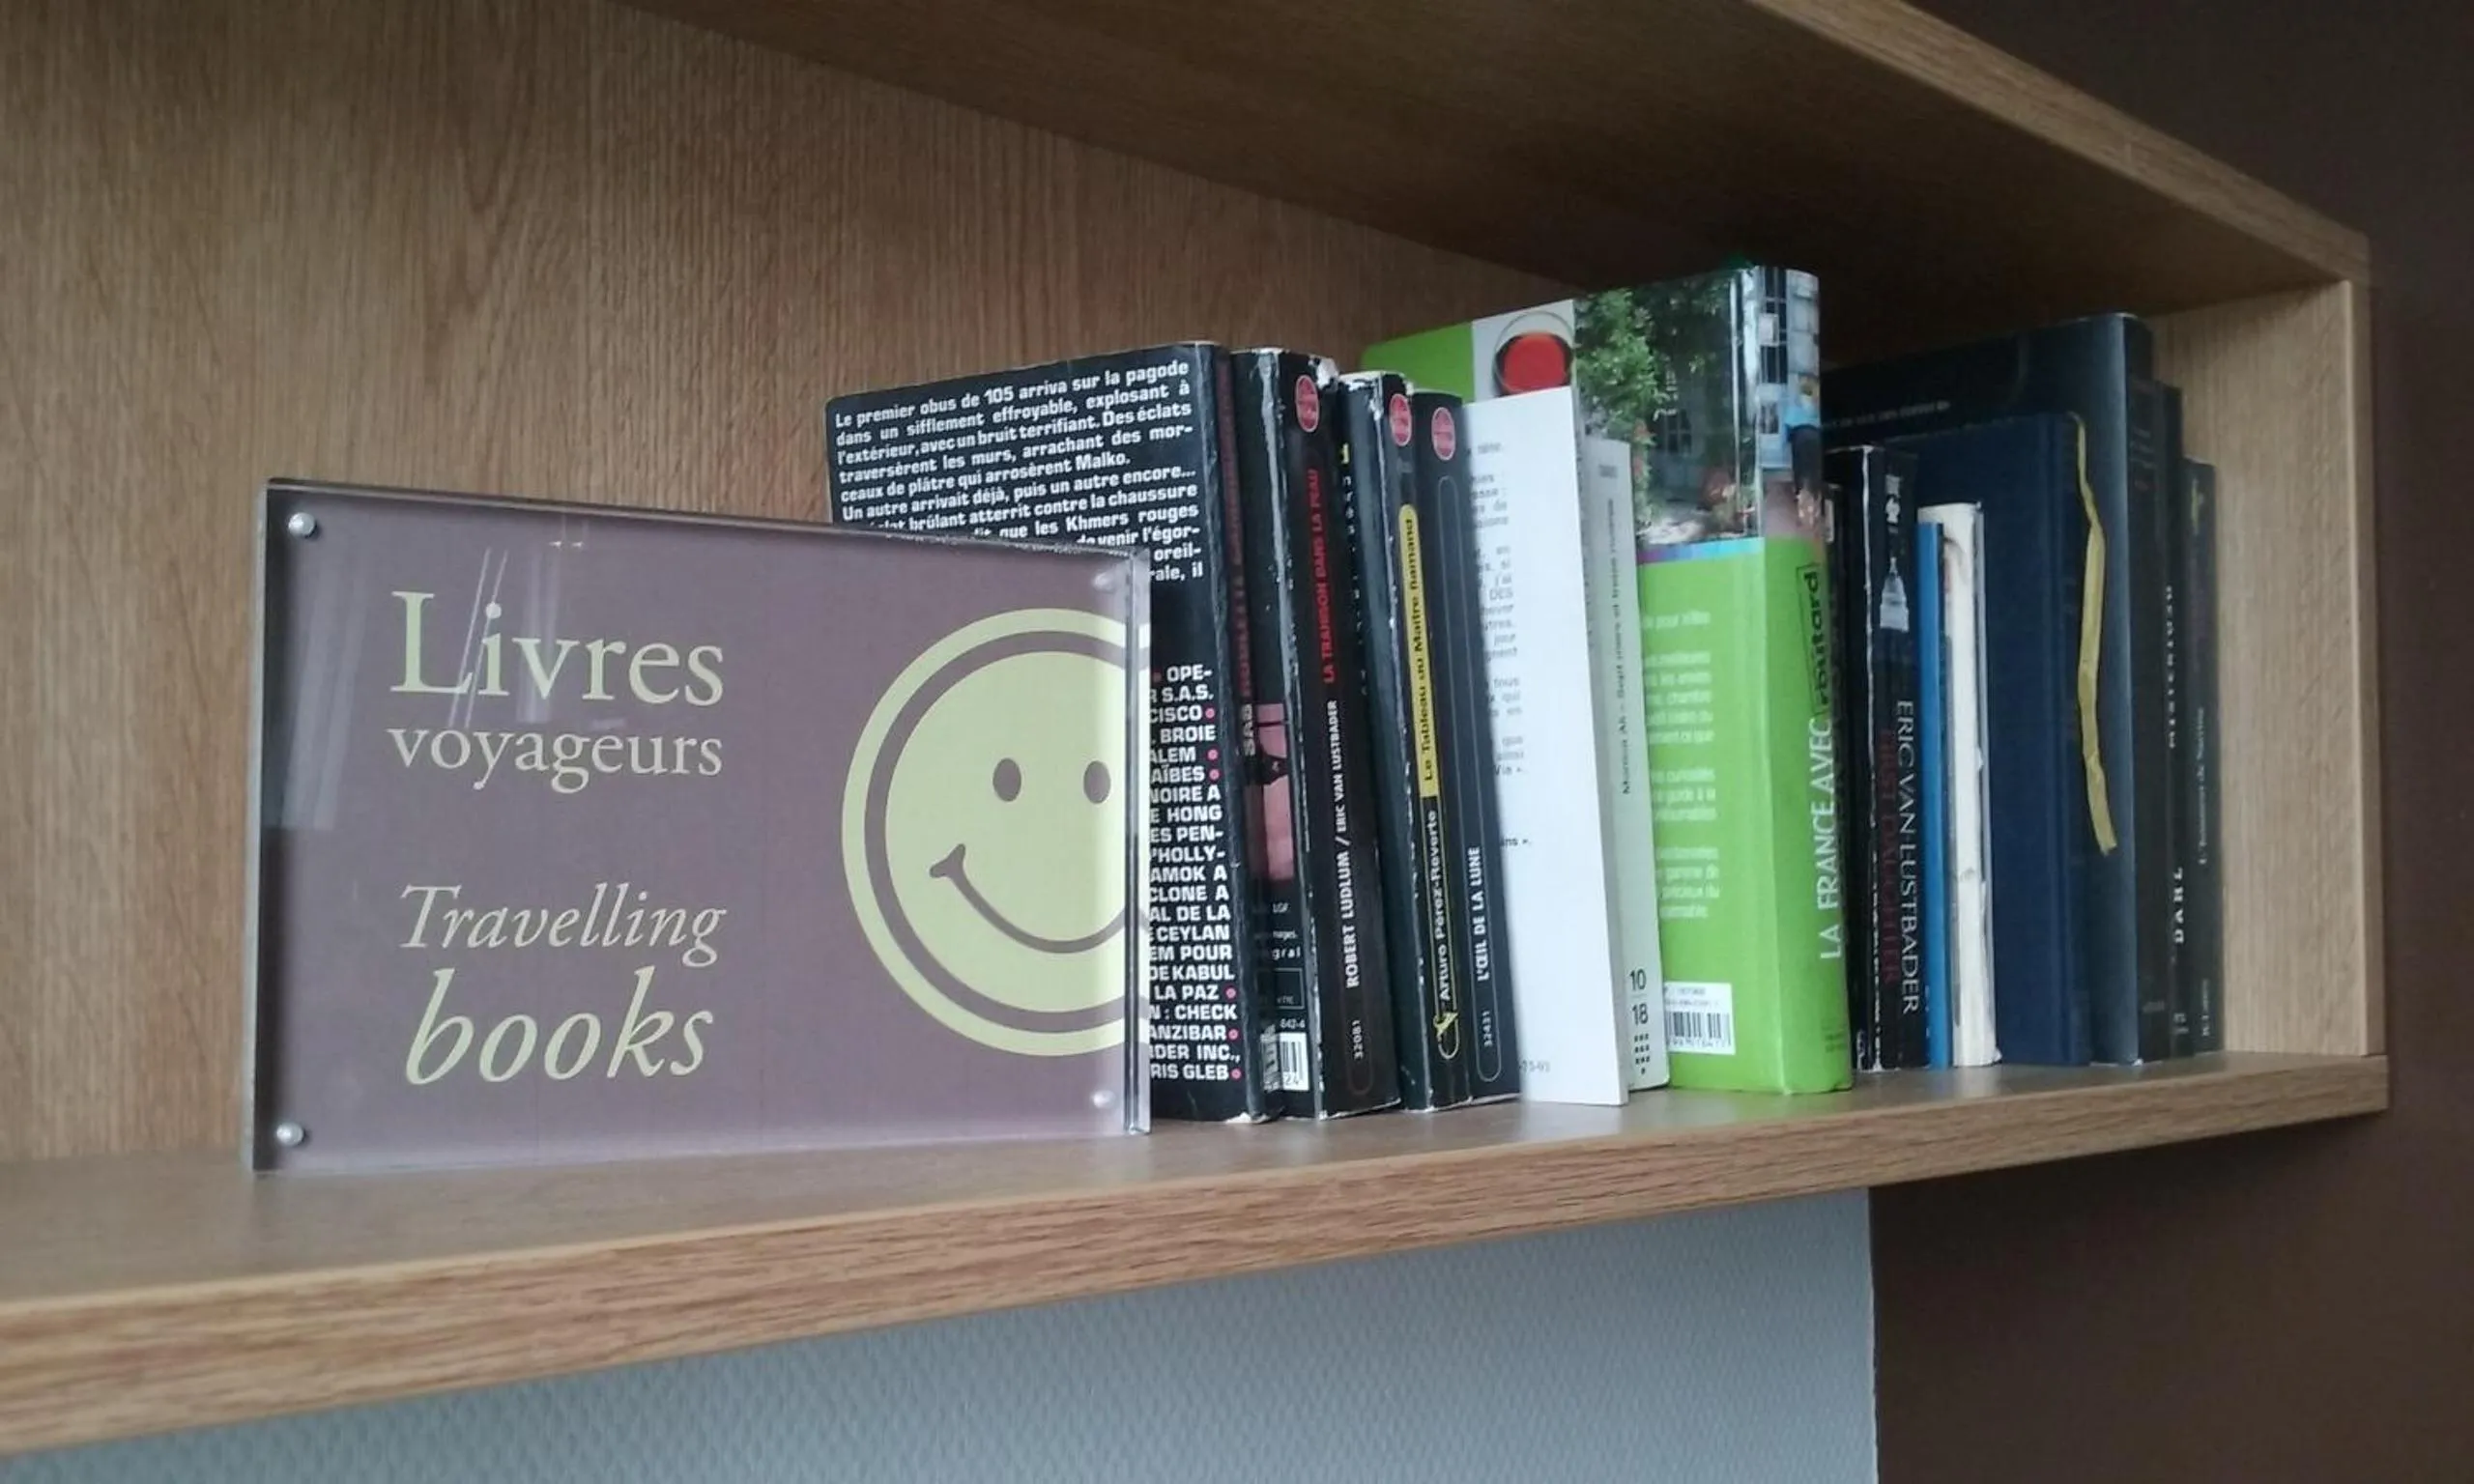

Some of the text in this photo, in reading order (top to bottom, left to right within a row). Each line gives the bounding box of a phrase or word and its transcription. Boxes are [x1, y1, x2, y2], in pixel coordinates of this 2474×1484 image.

[835, 359, 1189, 428] Le premier obus de 105 arriva sur la pagode
[836, 380, 1190, 446] dans un sifflement effroyable, explosant à
[920, 438, 955, 453] avec
[957, 435, 975, 447] un
[977, 426, 1018, 444] bruit
[1019, 415, 1101, 439] terrifiant.
[1102, 411, 1135, 427] Des
[1137, 402, 1192, 421] éclats
[839, 425, 1194, 484] traversèrent les murs, arrachant des mor-
[841, 451, 1131, 502] ceaux de plâtre qui arrosèrent Malko.
[843, 465, 1196, 521] Un autre arrivait déjà, puis un autre encore...
[909, 513, 966, 530] brûlant
[969, 504, 1031, 524] atterrit
[1033, 497, 1087, 516] contre
[1090, 494, 1106, 509] la
[1108, 483, 1198, 506] chaussure
[1034, 520, 1058, 536] les
[1066, 512, 1129, 532] Khmers
[1137, 502, 1199, 524] rouges
[1310, 513, 1322, 533] LA
[1154, 542, 1201, 561] oreil-
[1312, 538, 1329, 579] DANS
[1192, 561, 1203, 578] il
[1315, 583, 1335, 661] TRAHISON
[390, 590, 723, 706] Livres
[1166, 663, 1213, 683] OPE-
[1323, 664, 1336, 684] LA
[1416, 658, 1427, 678] du
[1162, 684, 1214, 701] S.A.S.
[1242, 702, 1256, 756] SAS
[1418, 685, 1432, 752] Tableau
[1160, 725, 1216, 743] BROIE
[1326, 699, 1342, 771] LUSTBADER
[386, 728, 723, 793] voyageurs
[1807, 717, 1836, 794] AVEC
[1424, 759, 1434, 782] Le
[1150, 784, 1222, 803] NOIRE A
[1333, 774, 1345, 803] VAN
[1166, 804, 1223, 822] HONG
[1334, 804, 1347, 833] ERIC
[1177, 825, 1224, 842] PEN-
[1467, 846, 1482, 887] LUNE
[1810, 800, 1841, 909] FRANCE
[1896, 699, 1920, 1014] ERIC VAN LUSTBADER
[1151, 865, 1228, 882] AMOK A
[1336, 851, 1355, 920] LUDLUM
[1150, 884, 1229, 902] CLONE A
[1471, 891, 1485, 913] LA
[399, 881, 727, 967] Travelling
[1176, 905, 1201, 922] DE
[1206, 904, 1231, 921] LA
[1472, 915, 1486, 936] DE
[1157, 925, 1230, 941] CEYLAN
[1819, 925, 1842, 959] LA
[1180, 944, 1233, 960] POUR
[1341, 924, 1360, 988] ROBERT
[1172, 963, 1235, 982] KABUL
[1435, 944, 1452, 1002] Arturo
[1629, 967, 1647, 991] 10
[1154, 984, 1220, 1001] LA PAZ
[406, 965, 713, 1085] books
[1174, 1004, 1237, 1020] CHECK
[1631, 1002, 1649, 1025] 18
[1150, 1024, 1227, 1042] ANZIBAR
[1183, 1063, 1229, 1080] GLEB
